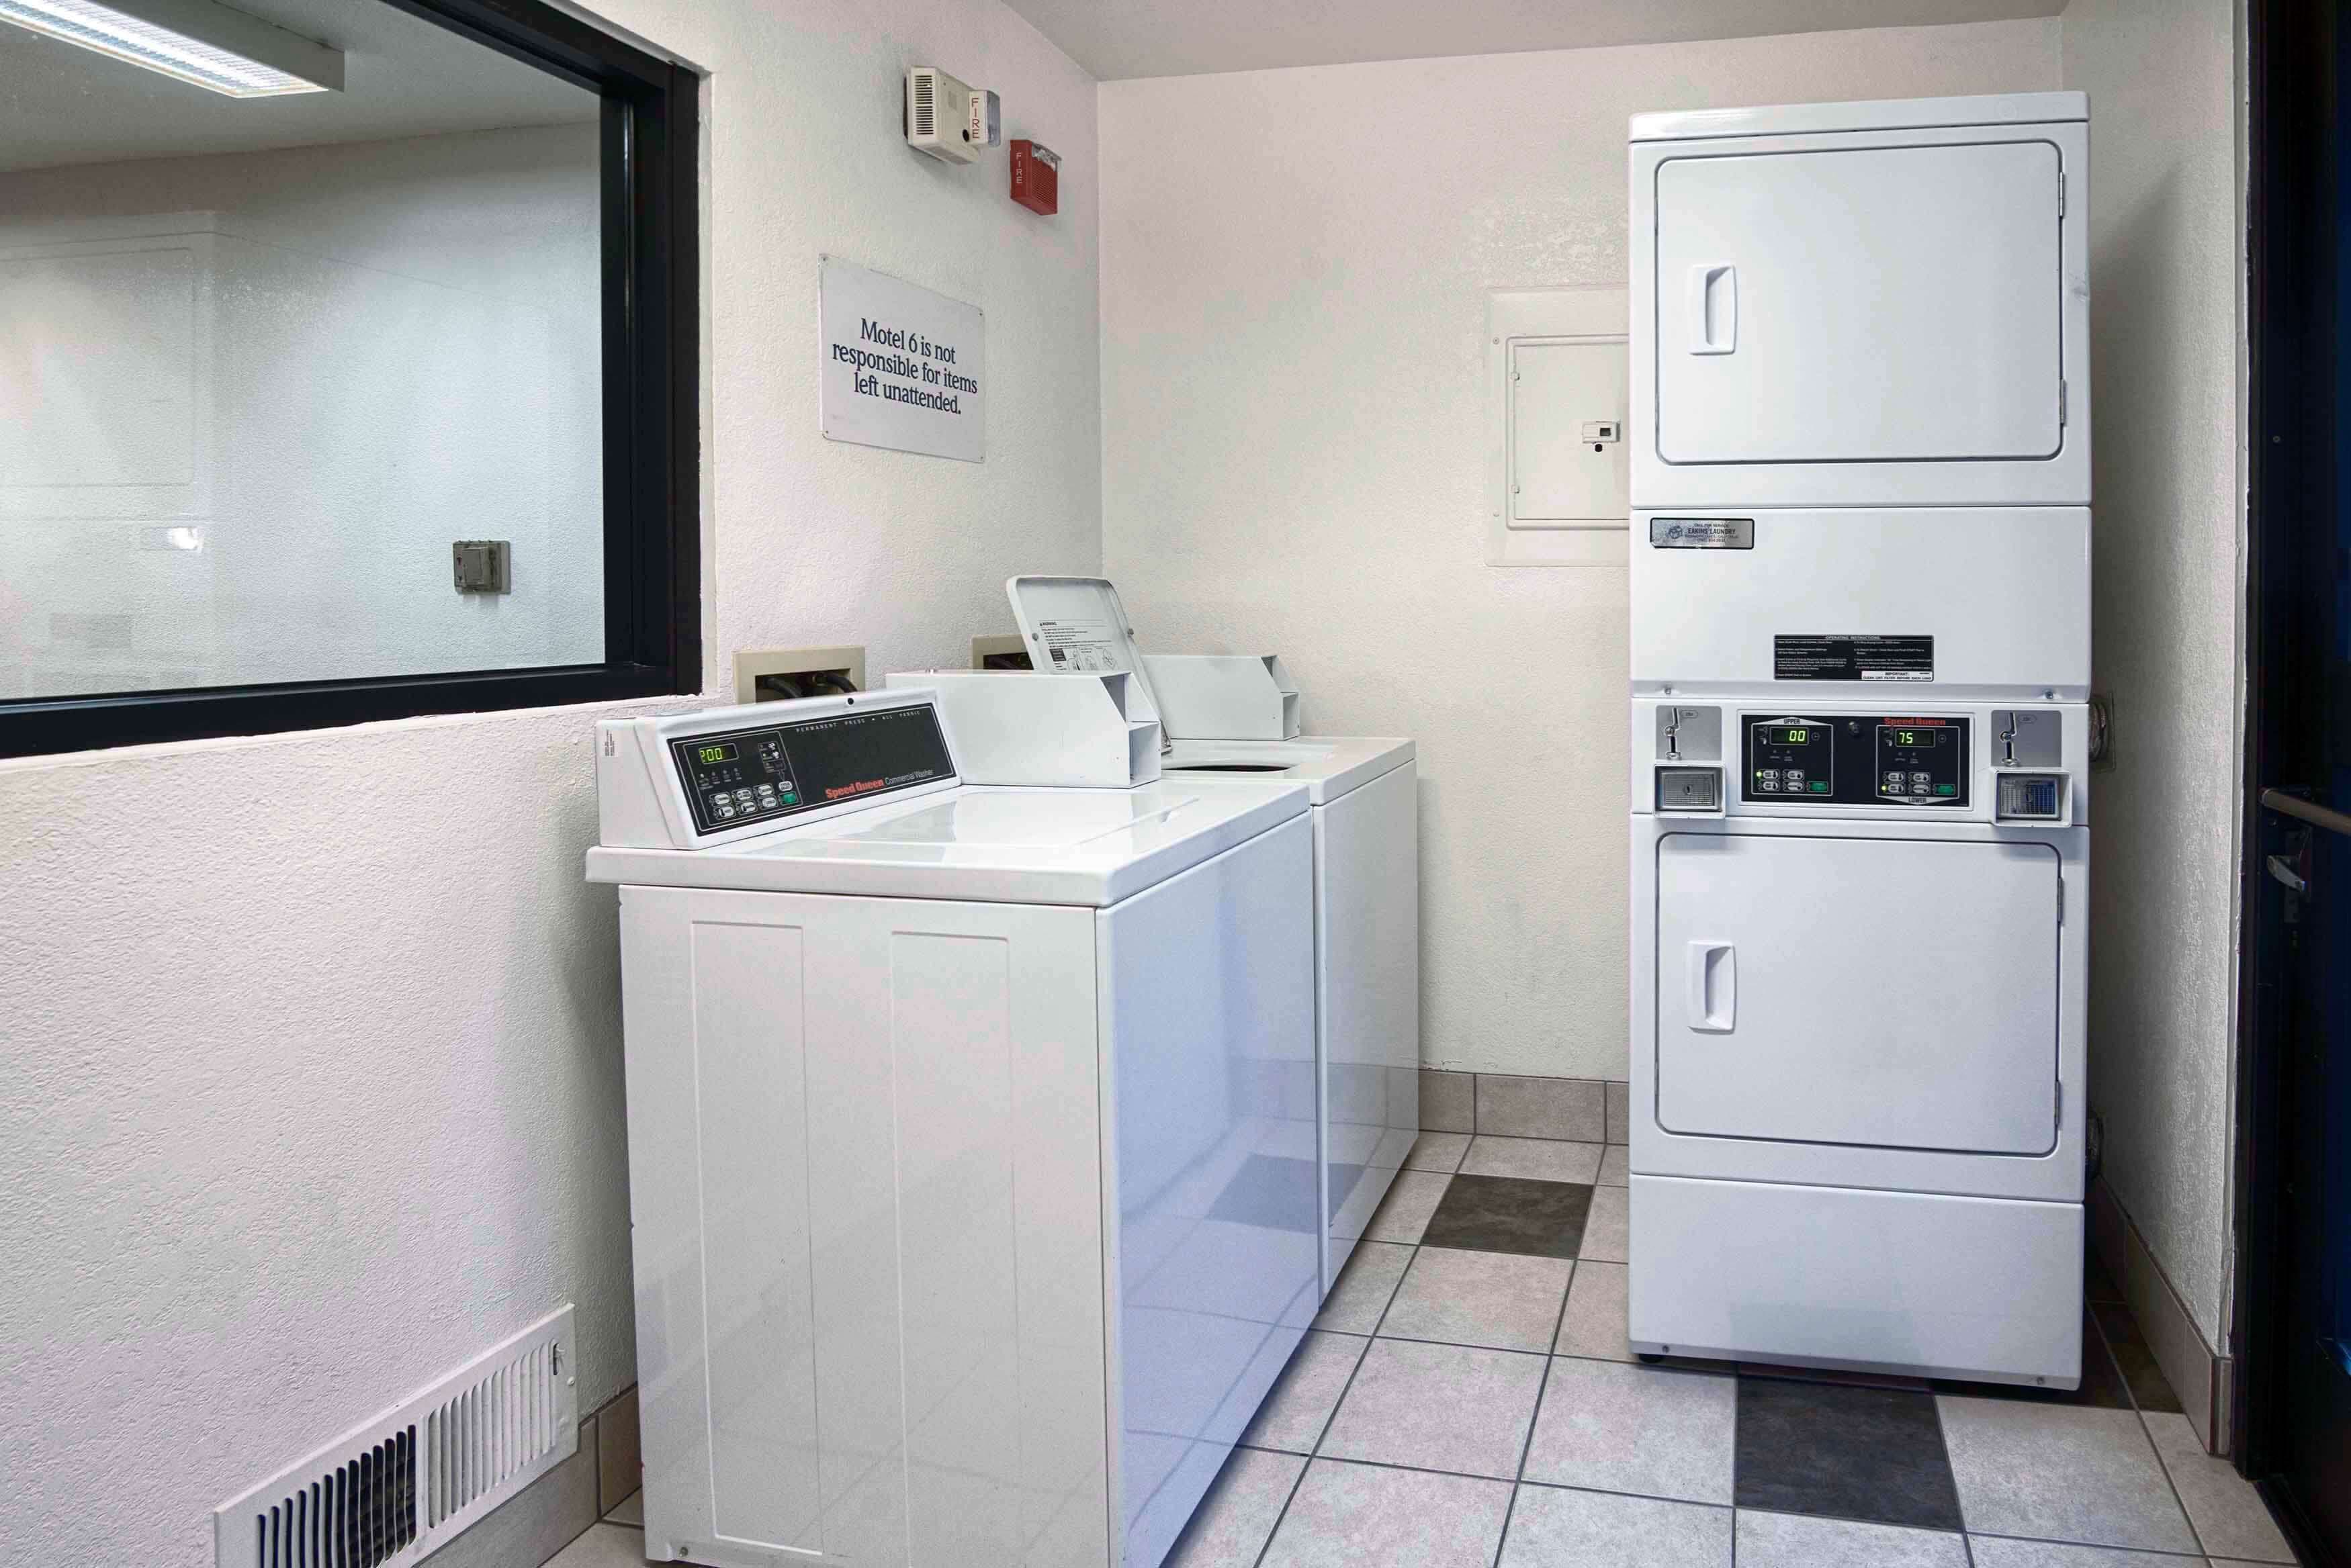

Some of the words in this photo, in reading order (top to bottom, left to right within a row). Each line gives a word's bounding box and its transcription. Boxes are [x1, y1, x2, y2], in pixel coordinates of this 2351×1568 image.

[971, 97, 980, 139] FIRE
[860, 318, 905, 351] Motel
[909, 333, 918, 353] 6
[921, 336, 931, 357] is
[934, 344, 957, 365] not
[832, 342, 918, 379] responsible
[922, 362, 940, 385] for
[943, 367, 978, 394] items
[854, 372, 879, 398] left
[883, 383, 962, 415] unattended.
[795, 723, 838, 733] PERMANENT
[1789, 730, 1806, 742] 00
[1883, 717, 1914, 726] Speed
[1915, 717, 1946, 726] Queen
[1898, 732, 1914, 743] 75
[825, 784, 856, 799] Speed
[855, 779, 885, 792] Queen
[885, 774, 915, 785] Commercial
[914, 770, 933, 778] Washer
